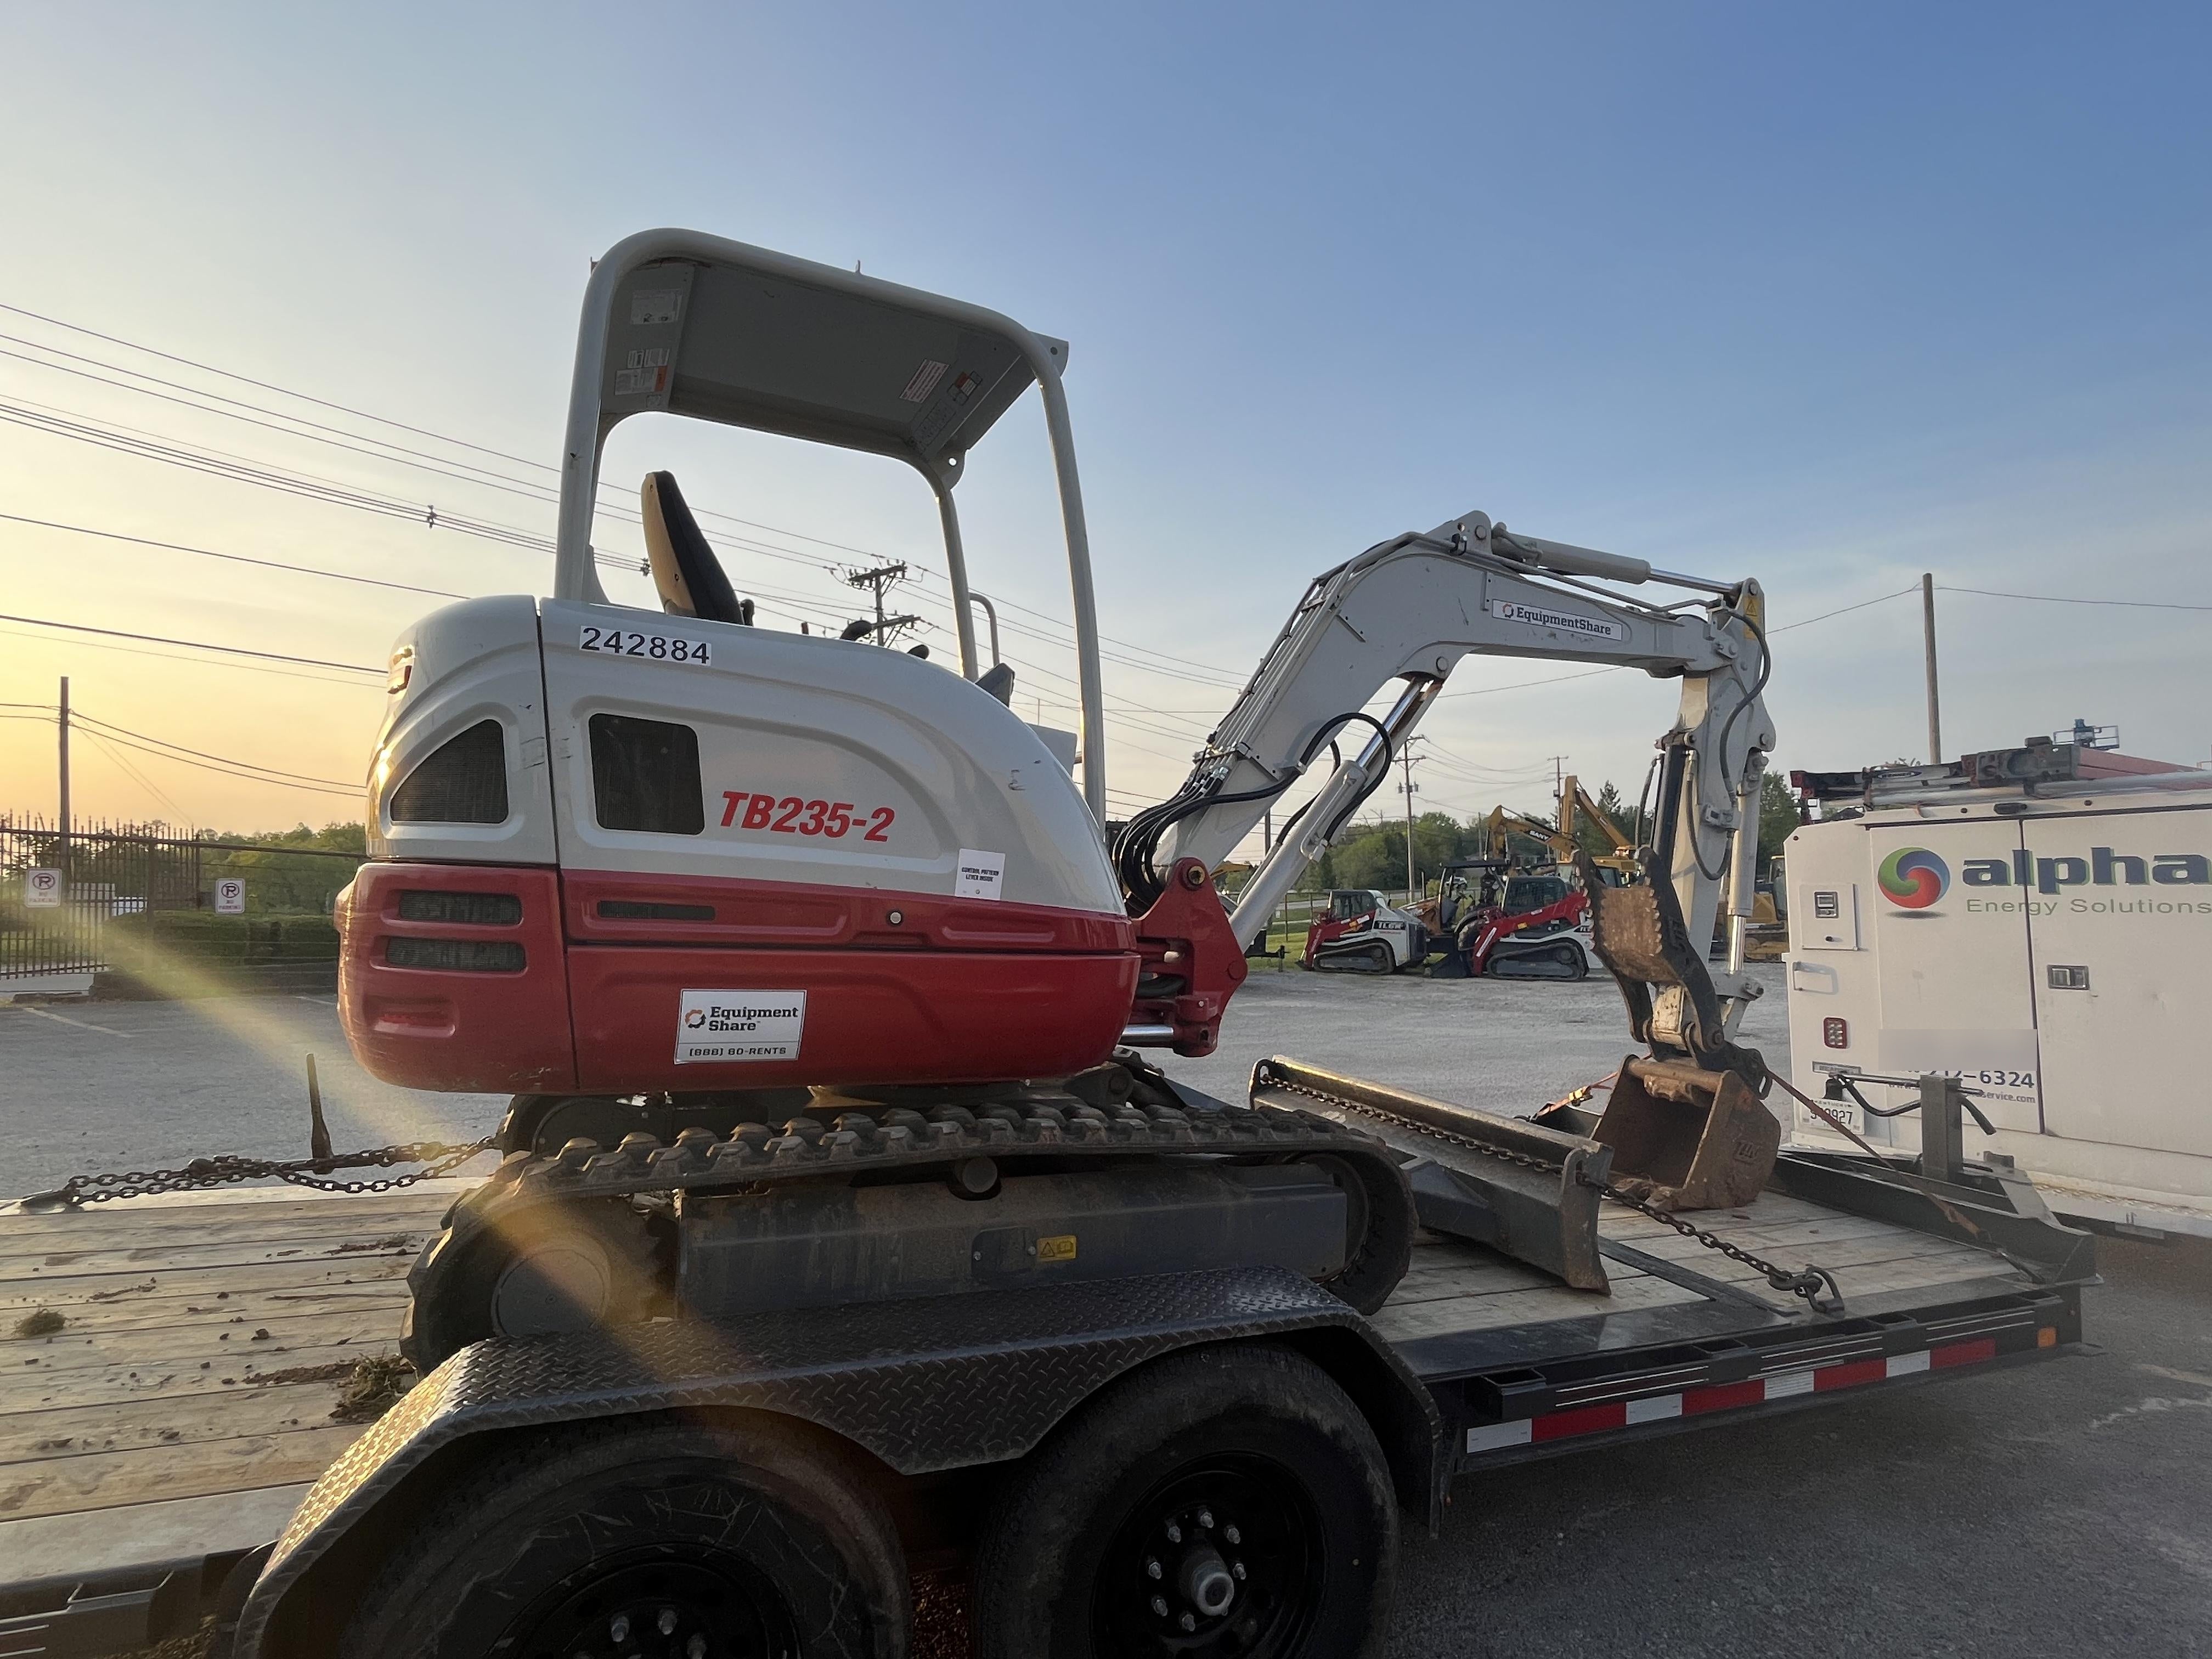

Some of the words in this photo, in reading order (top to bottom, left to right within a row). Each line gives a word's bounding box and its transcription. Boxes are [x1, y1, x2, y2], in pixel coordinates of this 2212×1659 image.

[1516, 607, 1611, 635] EquipmentShare
[581, 627, 709, 664] 242884
[720, 791, 895, 842] TB235-2
[1962, 847, 2212, 894] alpha
[1966, 899, 2058, 916] Energy
[2070, 898, 2212, 915] Solutions
[710, 1006, 799, 1020] Equipment
[708, 1020, 757, 1031] Share
[728, 1047, 787, 1056] 80-RENTS
